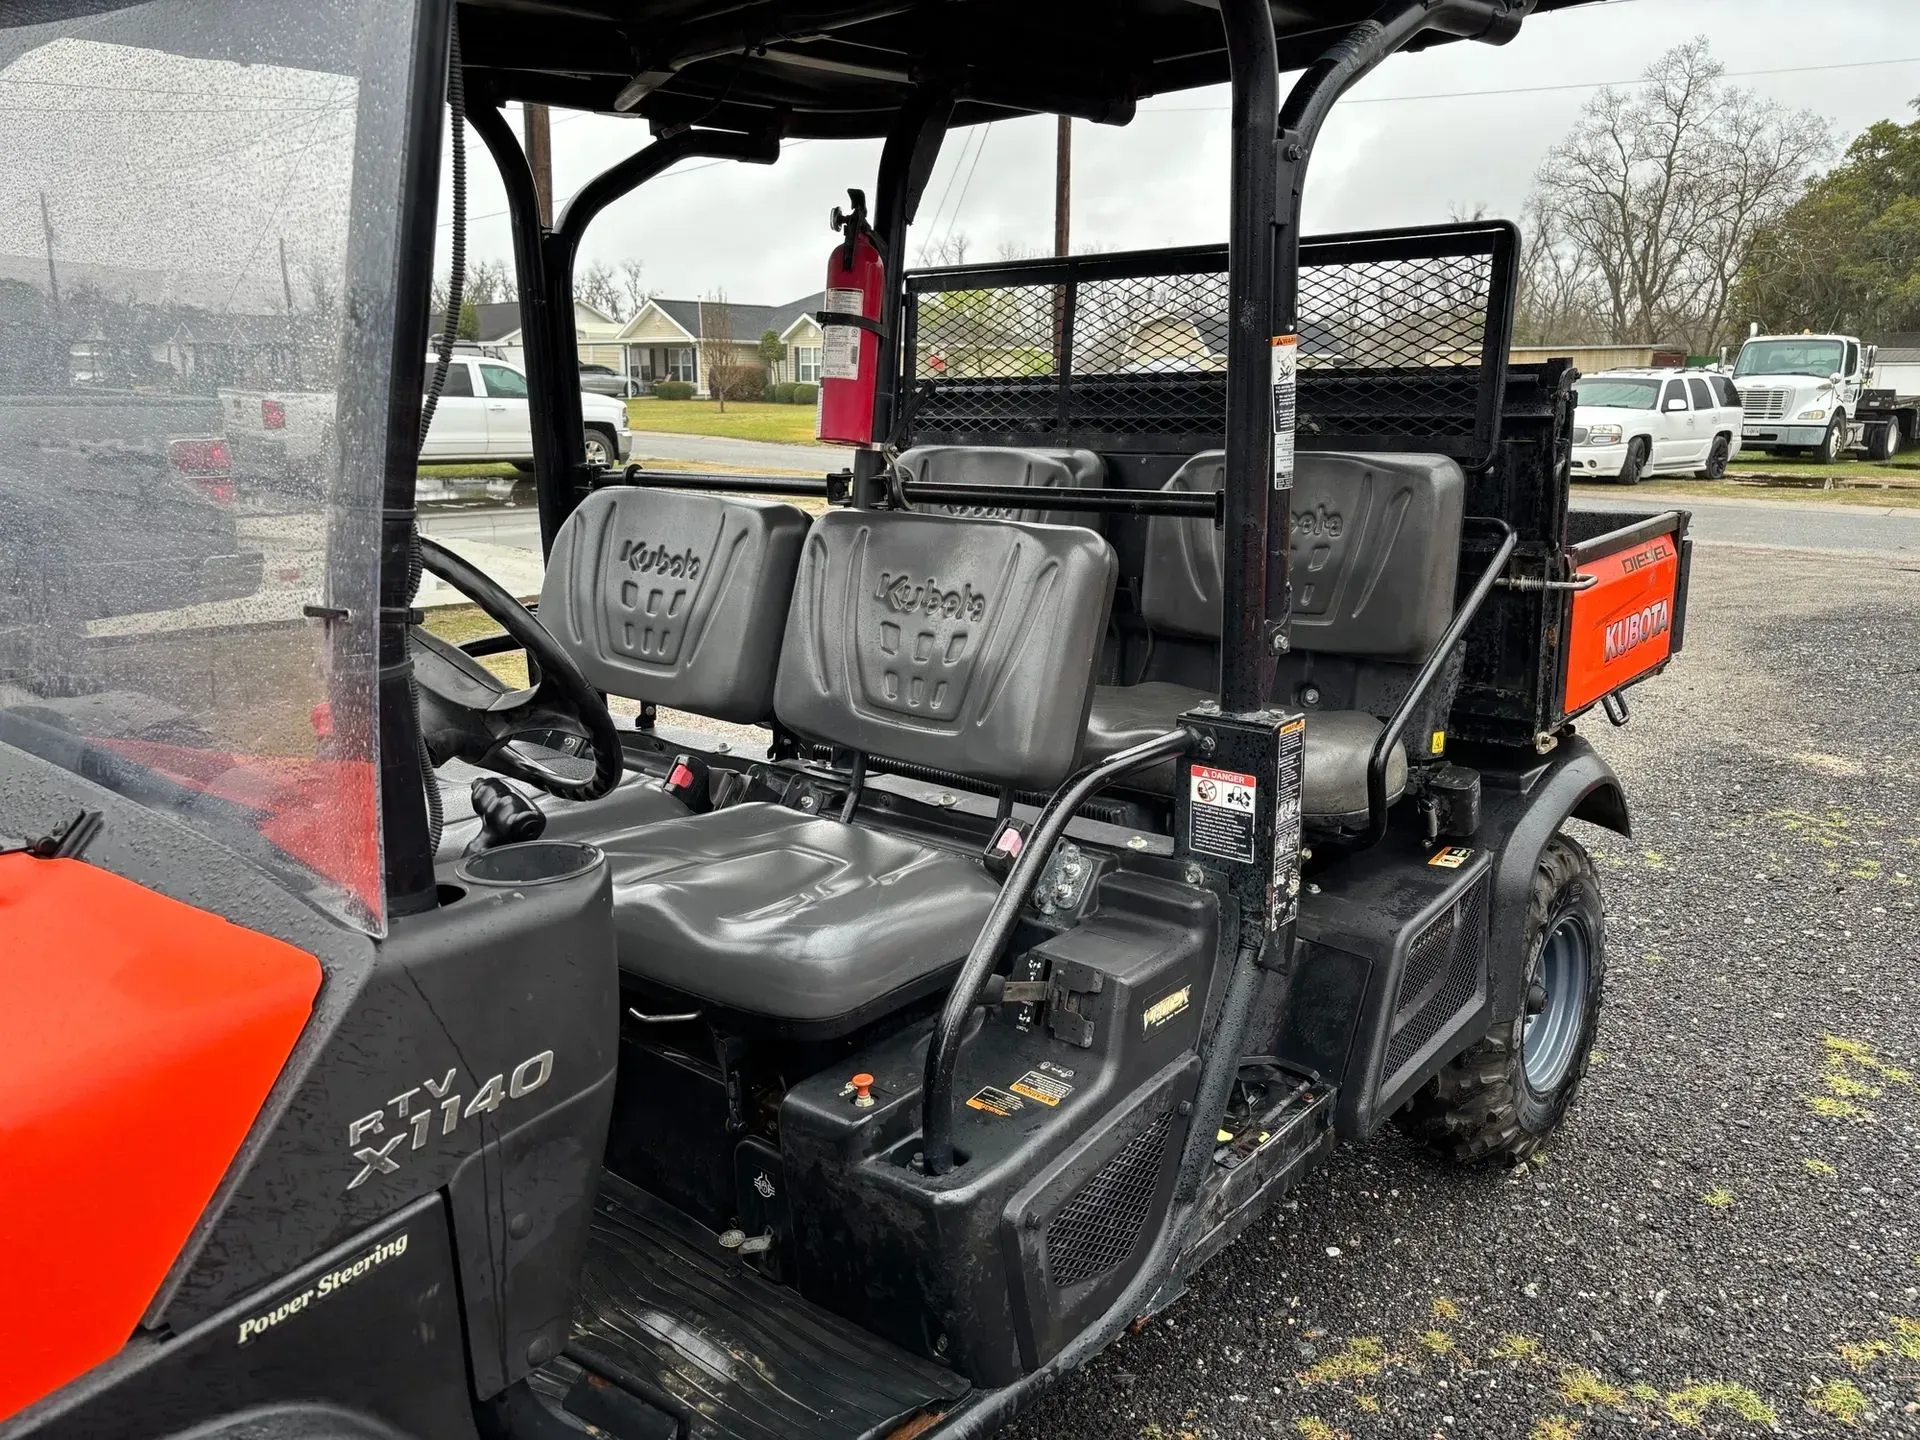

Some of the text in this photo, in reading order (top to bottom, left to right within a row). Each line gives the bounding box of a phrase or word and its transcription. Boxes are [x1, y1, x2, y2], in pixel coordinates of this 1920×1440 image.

[619, 539, 701, 580] Kubota
[1621, 544, 1673, 574] DIESEL
[875, 572, 985, 622] Kubota
[1604, 599, 1669, 663] KUBOTA
[1211, 770, 1245, 784] DANGER
[346, 1050, 554, 1190] X1140
[350, 1067, 457, 1147] RTV
[238, 1232, 408, 1344] Power Steering
